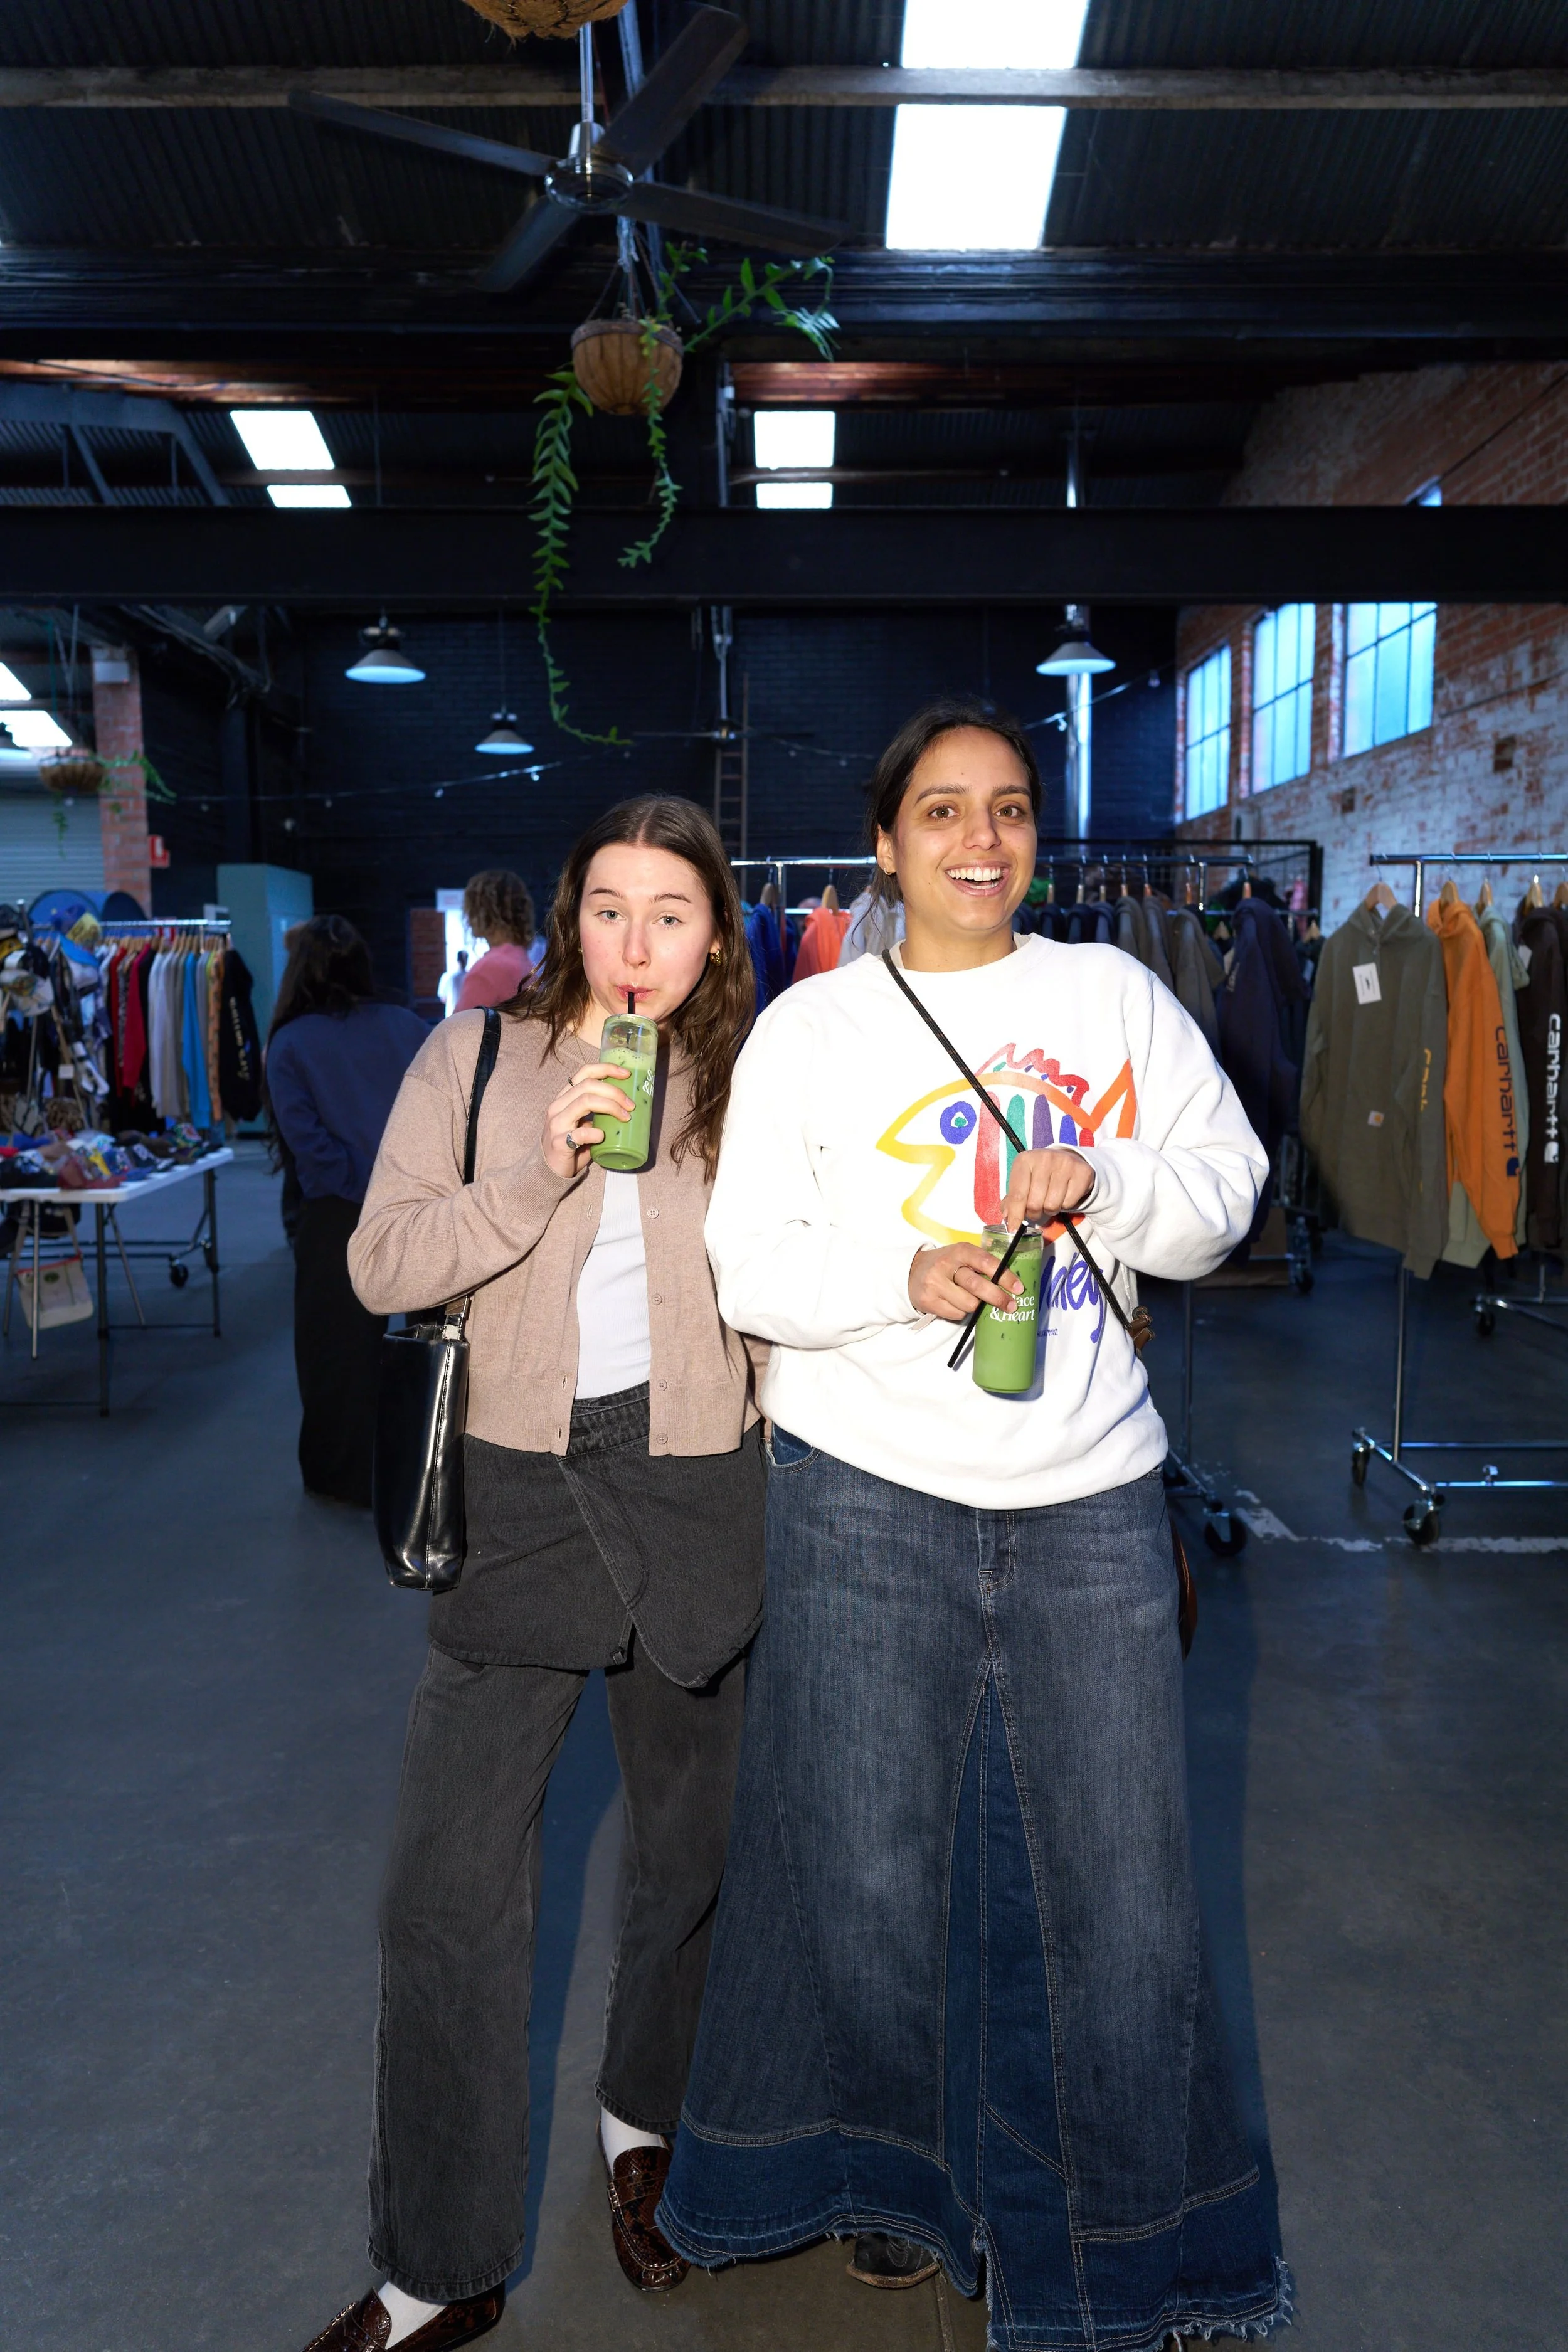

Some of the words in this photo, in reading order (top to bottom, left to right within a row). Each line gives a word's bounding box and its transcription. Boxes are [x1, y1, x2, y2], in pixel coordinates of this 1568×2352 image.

[1495, 1025, 1517, 1152] carhartt
[1545, 1014, 1561, 1139] carhartt
[990, 1306, 1003, 1322] &
